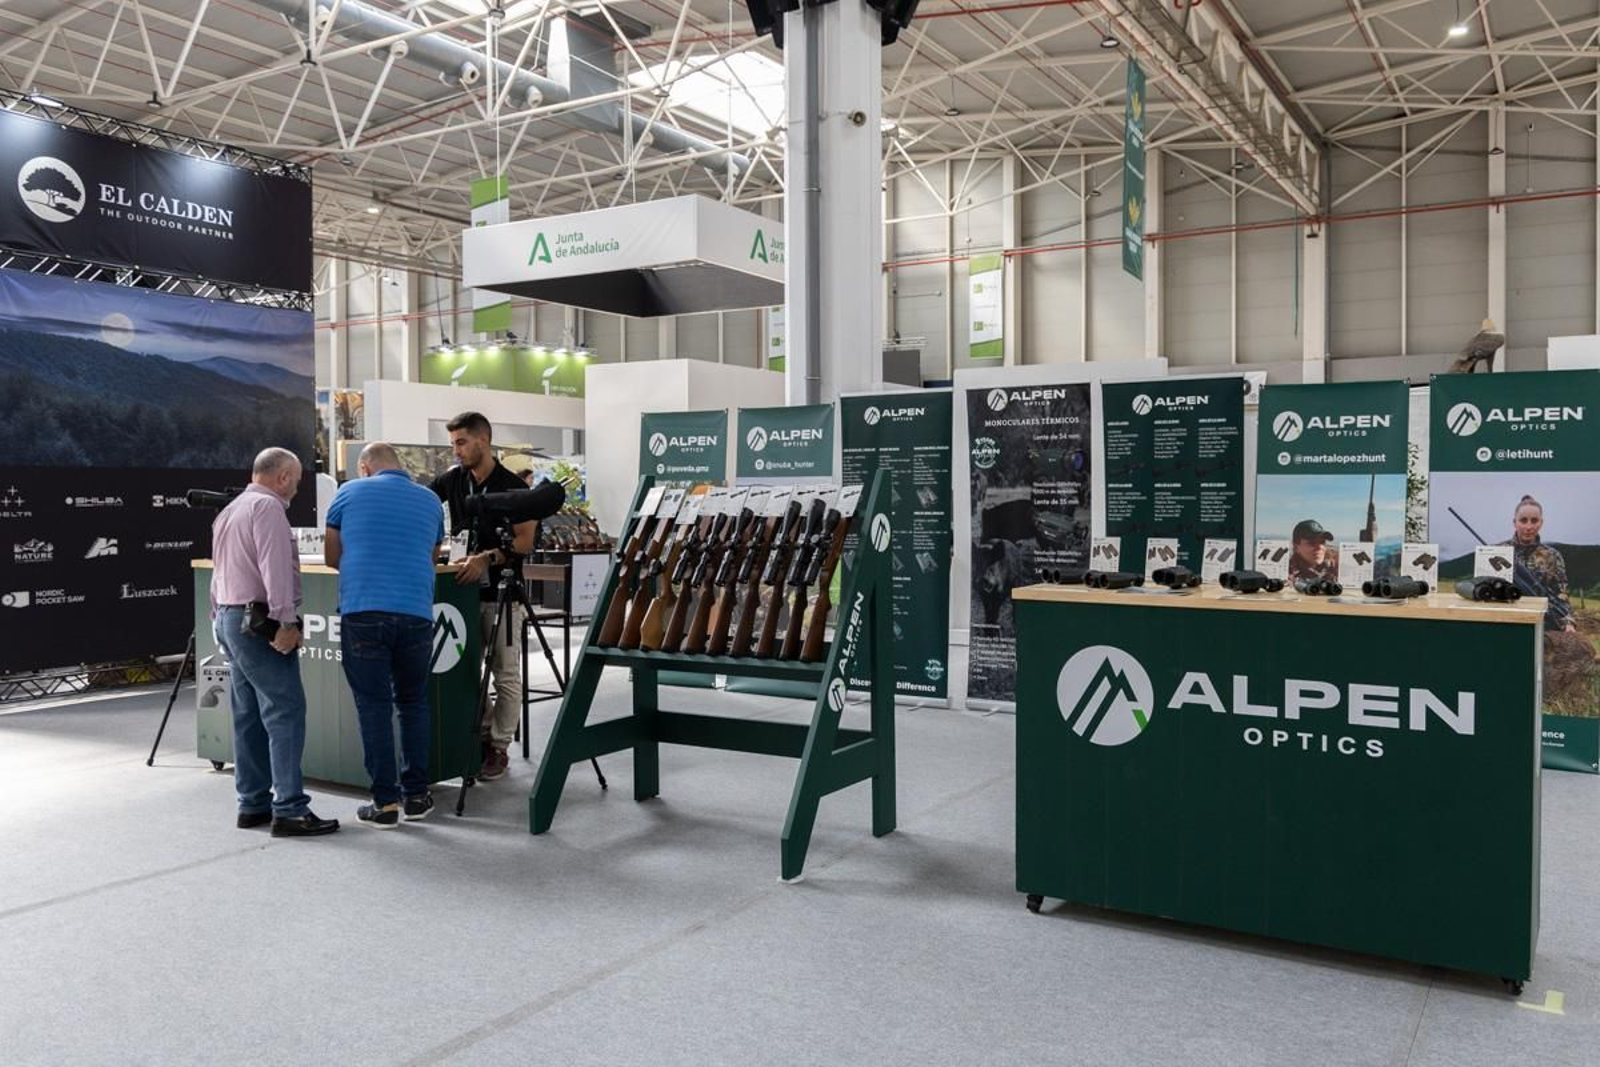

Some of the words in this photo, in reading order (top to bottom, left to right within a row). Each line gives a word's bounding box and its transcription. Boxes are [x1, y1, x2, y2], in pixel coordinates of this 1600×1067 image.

[98, 183, 132, 207] EL
[139, 192, 233, 227] CALDEN
[99, 207, 121, 218] THE
[127, 213, 182, 230] OUTDOOR
[187, 225, 234, 240] PARTNER
[555, 232, 584, 245] Junta
[555, 247, 568, 258] de
[570, 238, 619, 256] Andalucía
[1010, 389, 1066, 401] ALPEN
[1154, 396, 1209, 406] ALPEN
[882, 407, 926, 417] ALPEN
[1486, 406, 1584, 422] ALPEN
[984, 418, 1040, 428] MONOCULARES
[1307, 414, 1391, 429] ALPEN
[1510, 423, 1557, 431] OPTICS
[669, 435, 718, 447] ALPEN
[769, 428, 823, 441] ALPEN
[1294, 452, 1387, 465] @martalopezhunt
[1495, 449, 1553, 461] @letihunt
[14, 552, 54, 561] NATURE
[36, 588, 64, 597] NORDIC
[36, 596, 65, 605] POCKET
[68, 595, 86, 603] SAW
[303, 614, 342, 641] PE
[839, 591, 864, 675] ALPEN
[299, 647, 343, 662] PTICS
[849, 677, 871, 687] Disco
[896, 681, 937, 692] Difference
[1167, 671, 1476, 736] ALPEN
[1541, 731, 1566, 740] ence
[1243, 726, 1385, 759] OPTICS
